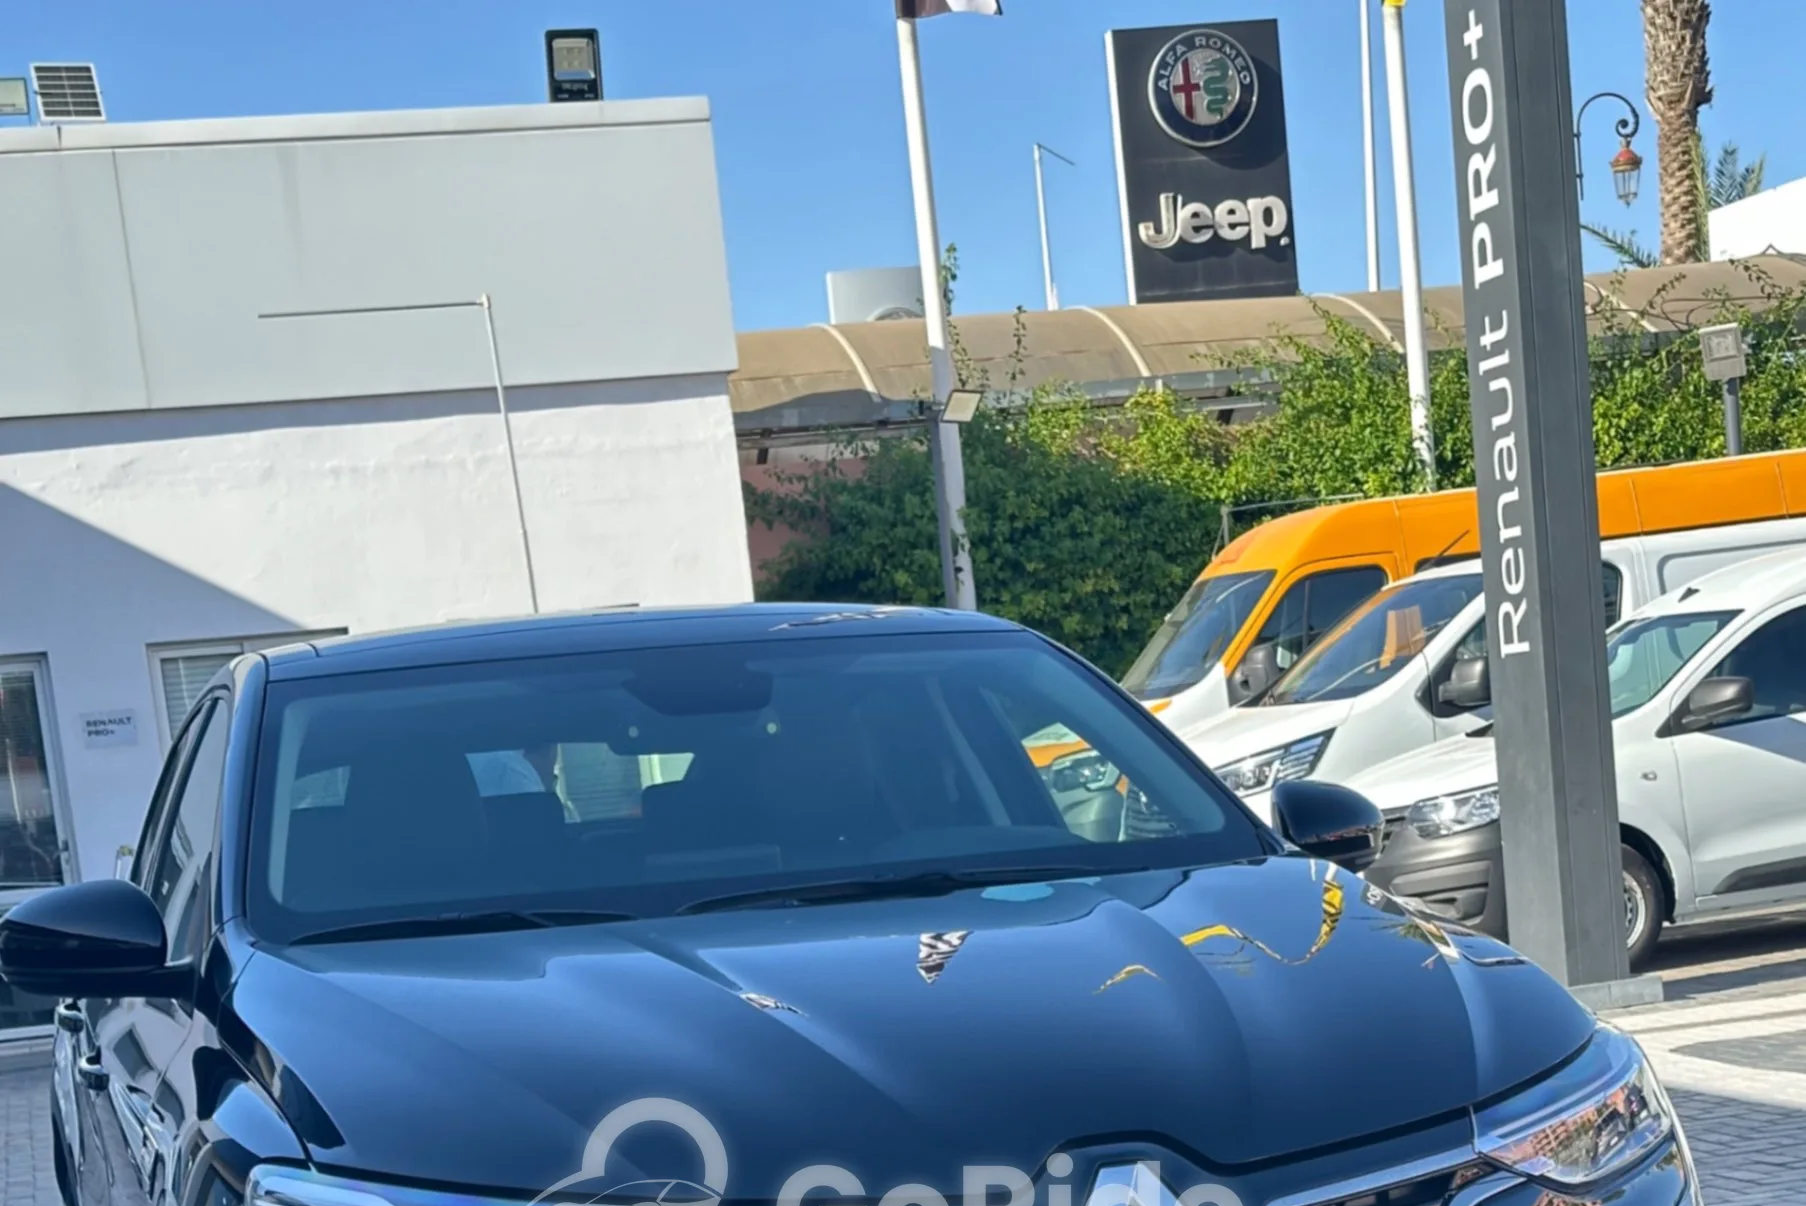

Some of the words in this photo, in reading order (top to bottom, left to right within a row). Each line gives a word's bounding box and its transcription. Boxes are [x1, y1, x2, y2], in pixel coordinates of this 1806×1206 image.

[1157, 44, 1188, 91] ALFA
[1194, 36, 1250, 86] ROMEO
[1462, 9, 1504, 290] PRO+
[1479, 309, 1531, 658] Renault
[86, 716, 132, 728] RENAULT
